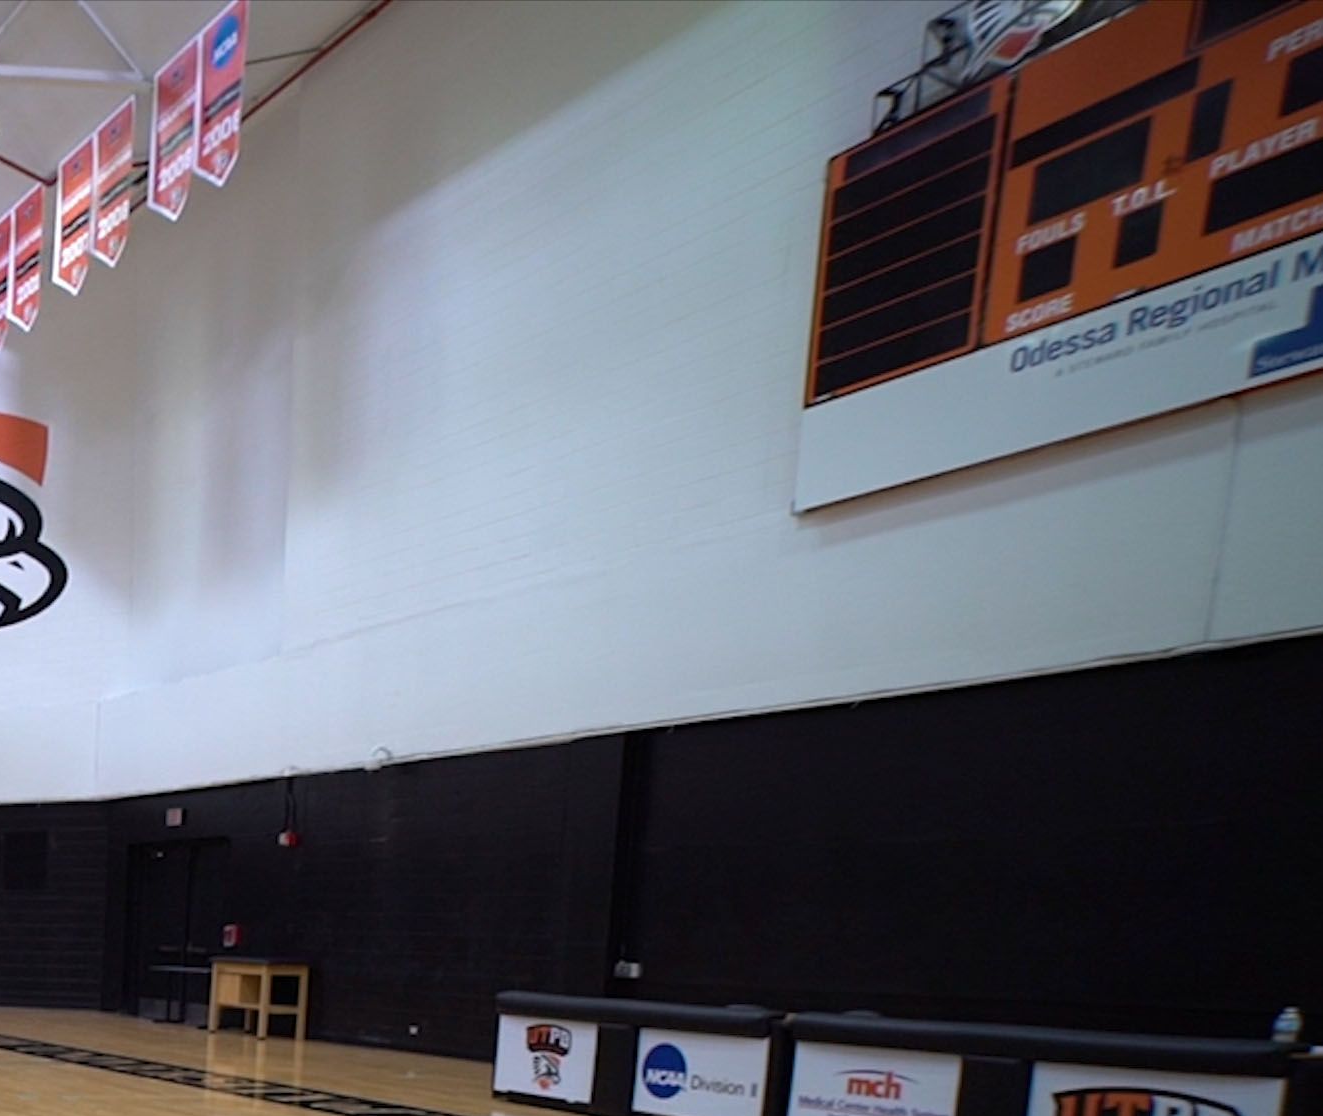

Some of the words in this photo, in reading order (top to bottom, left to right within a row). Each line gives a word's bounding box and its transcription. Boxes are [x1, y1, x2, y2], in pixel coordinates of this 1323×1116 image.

[1208, 116, 1321, 178] PLAYER
[1110, 179, 1177, 217] T.O.L.
[1014, 211, 1088, 256] FOULS
[1005, 292, 1075, 334] SCORE
[1009, 320, 1116, 374] Odessa
[1126, 259, 1282, 330] Regional
[528, 1026, 570, 1049] UTPB
[646, 1068, 689, 1090] NCAA
[691, 1074, 746, 1096] Division
[847, 1071, 903, 1100] mch
[798, 1095, 834, 1108] Medical
